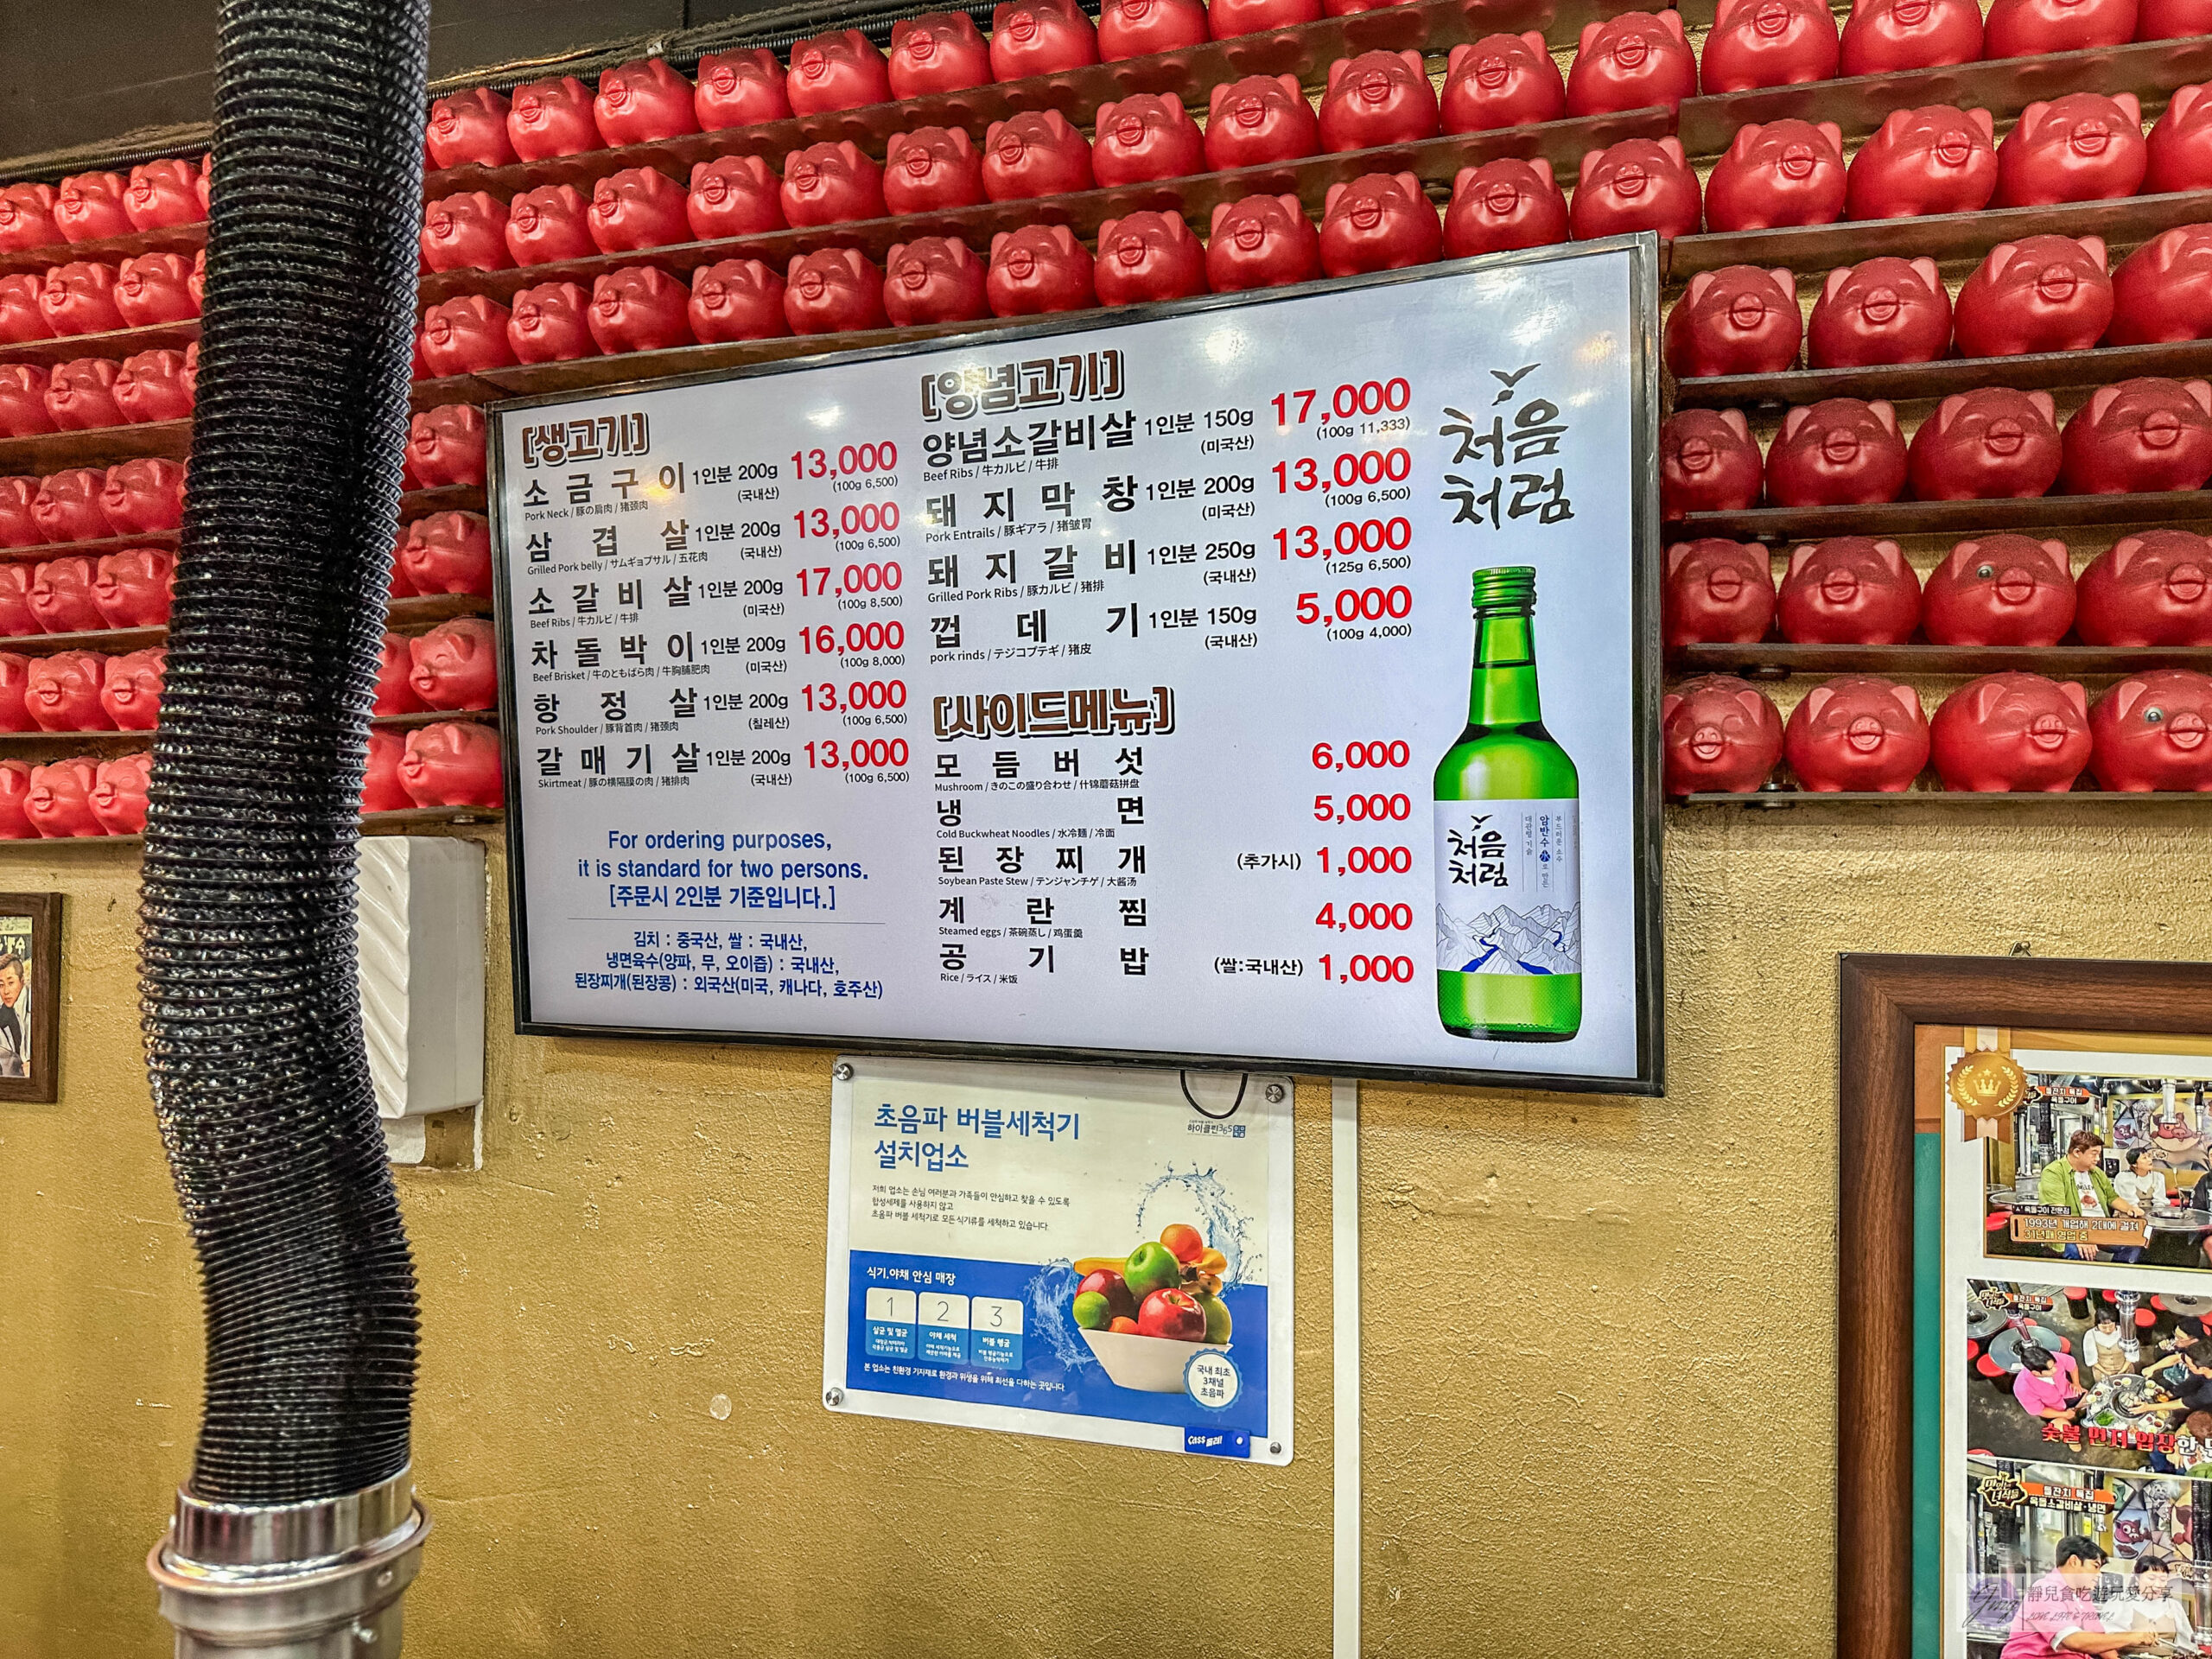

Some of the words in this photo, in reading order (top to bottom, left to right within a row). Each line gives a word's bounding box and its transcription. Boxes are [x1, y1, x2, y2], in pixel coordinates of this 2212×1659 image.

[921, 349, 1125, 422] [양념고기]
[923, 410, 1137, 467] 양념소갈비살
[1145, 414, 1195, 437] 1인분
[1204, 409, 1255, 430] 150g
[1271, 377, 1411, 428] 17,000
[1316, 423, 1354, 440] (100g
[1359, 417, 1411, 434] 11,333)
[1440, 398, 1569, 467] 처음
[523, 412, 650, 468] [생고기]
[692, 467, 733, 486] 1인분
[738, 463, 778, 482] 200g
[791, 441, 897, 480] 13,000
[923, 471, 947, 482] Beef
[950, 468, 973, 480] Ribs
[982, 461, 1026, 476] 牛カルビ
[1035, 456, 1059, 472] 牛排
[1146, 479, 1196, 501] 1인분
[1204, 474, 1255, 495] 200g
[1272, 448, 1412, 494] 13,000
[524, 512, 545, 522] Pork
[548, 509, 569, 519] Neck
[575, 503, 613, 517] 豚の肩肉
[1440, 468, 1575, 531] 처럼
[696, 524, 735, 543] 1인분
[741, 521, 781, 539] 200g
[794, 502, 899, 539] 13,000
[1147, 544, 1198, 566] 1인분
[1205, 541, 1256, 562] 250g
[1273, 517, 1412, 562] 13,000
[698, 581, 738, 599] 1인분
[744, 579, 783, 597] 200g
[797, 562, 902, 598] 17,000
[928, 591, 964, 603] Grilled
[967, 588, 993, 601] Pork
[995, 587, 1018, 599] Ribs
[1027, 582, 1071, 598] 豚カルビ
[1081, 580, 1105, 594] 猪排
[743, 602, 785, 618] (미국산)
[1148, 610, 1198, 631] 1인분
[1207, 607, 1257, 627] 150g
[1296, 585, 1413, 626] 5,000
[701, 638, 740, 655] 1인분
[746, 636, 785, 653] 200g
[799, 621, 905, 656] 16,000
[703, 695, 743, 712] 1인분
[749, 693, 788, 710] 200g
[802, 680, 906, 714] 13,000
[748, 717, 790, 731] (칠레산)
[933, 685, 1175, 741] [사이드메뉴]
[706, 750, 746, 767] 1인분
[752, 749, 791, 766] 200g
[804, 738, 909, 771] 13,000
[1313, 741, 1410, 772] 6,000
[538, 779, 582, 789] Skirtmeat
[1313, 793, 1412, 823] 5,000
[608, 830, 638, 849] For
[645, 830, 724, 850] ordering
[733, 832, 831, 851] purposes,
[936, 829, 956, 837] Cold
[959, 828, 1009, 838] Buckwheat
[1012, 828, 1050, 838] Noodles
[1095, 827, 1116, 838] 冷面
[1447, 830, 1507, 859] 처음
[579, 861, 589, 877] it
[596, 861, 612, 877] is
[618, 860, 700, 877] standard
[708, 860, 733, 877] for
[741, 861, 773, 878] two
[781, 861, 868, 880] persons.
[1236, 851, 1301, 871] (추가시)
[1317, 847, 1412, 876] 1,000
[1449, 860, 1509, 887] 처럼
[610, 885, 669, 908] [주문시
[676, 885, 721, 907] 2인분
[729, 886, 836, 910] 기준입니다.]
[1315, 901, 1413, 932] 4,000
[634, 931, 659, 947] 김치
[677, 932, 723, 949] 중국산,
[728, 933, 742, 948] 쌀
[760, 934, 807, 950] 국내산,
[607, 952, 696, 970] 냉면육수(양파,
[702, 955, 719, 972] 무,
[726, 956, 773, 973] 오이즙)
[791, 957, 839, 975] 국내산,
[1214, 956, 1304, 976] (쌀:국내산)
[1318, 953, 1414, 986] 1,000
[575, 973, 677, 991] 된장찌개(된장콩)
[694, 976, 773, 995] 외국산(미국,
[779, 978, 827, 997] 캐나다,
[833, 980, 883, 999] 호주산)
[940, 973, 959, 982] Rice
[966, 973, 992, 983] ライス
[1000, 973, 1018, 984] 米饭
[874, 1103, 948, 1135] 초음파
[957, 1108, 1080, 1141] 버블세척기
[874, 1140, 969, 1172] 설치업소
[1038, 1196, 1046, 1205] 수
[2024, 1218, 2057, 1229] 1993년
[2057, 1230, 2075, 1241] 영업
[2079, 1231, 2088, 1241] 중
[912, 1271, 932, 1284] 안심
[936, 1273, 956, 1286] 매장
[887, 1297, 893, 1317] 1
[938, 1301, 949, 1321] 2
[990, 1306, 1002, 1327] 3
[1198, 1365, 1212, 1375] 국내
[1215, 1367, 1230, 1376] 최초
[1204, 1377, 1224, 1388] 3채널
[1201, 1389, 1224, 1399] 초음파
